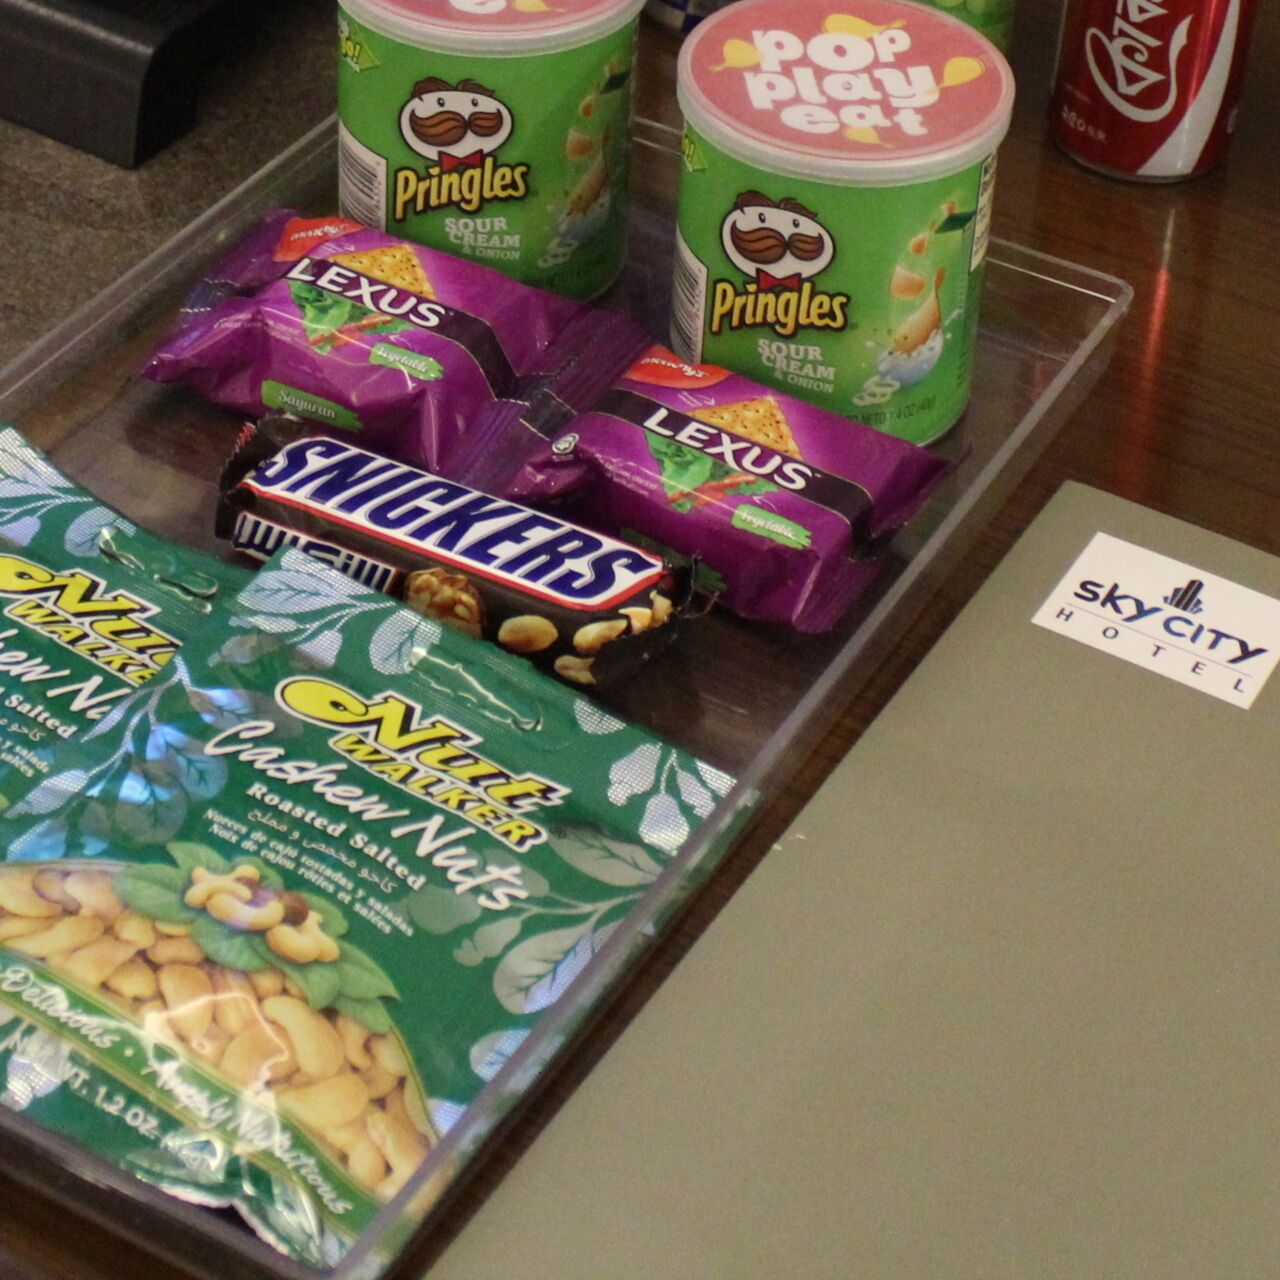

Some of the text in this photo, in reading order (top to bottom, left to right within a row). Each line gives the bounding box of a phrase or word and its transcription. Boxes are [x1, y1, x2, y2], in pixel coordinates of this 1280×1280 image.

[743, 65, 940, 110] play
[780, 104, 929, 136] eat
[395, 155, 529, 221] Pringles
[445, 217, 508, 233] SOUR
[449, 231, 521, 248] CREAM
[475, 248, 521, 261] ONION
[286, 257, 447, 327] LEXUS
[711, 279, 849, 337] Pringles
[757, 338, 823, 361] SOUR
[761, 353, 836, 381] CREAM
[279, 389, 336, 418] Sayuran
[787, 373, 834, 394] ONION
[643, 407, 814, 491] LEXUS
[252, 439, 658, 601] SNICKERS
[9, 600, 157, 685] WALKE
[1054, 607, 1246, 694] HOTEL
[4, 693, 79, 739] Salted
[46, 675, 132, 720] Nu
[334, 734, 543, 848] WALKER
[203, 721, 529, 912] Cashew Nuts
[246, 781, 427, 891] Roasted Salted
[301, 853, 355, 891] tostadas
[4, 966, 120, 1050] Delicious
